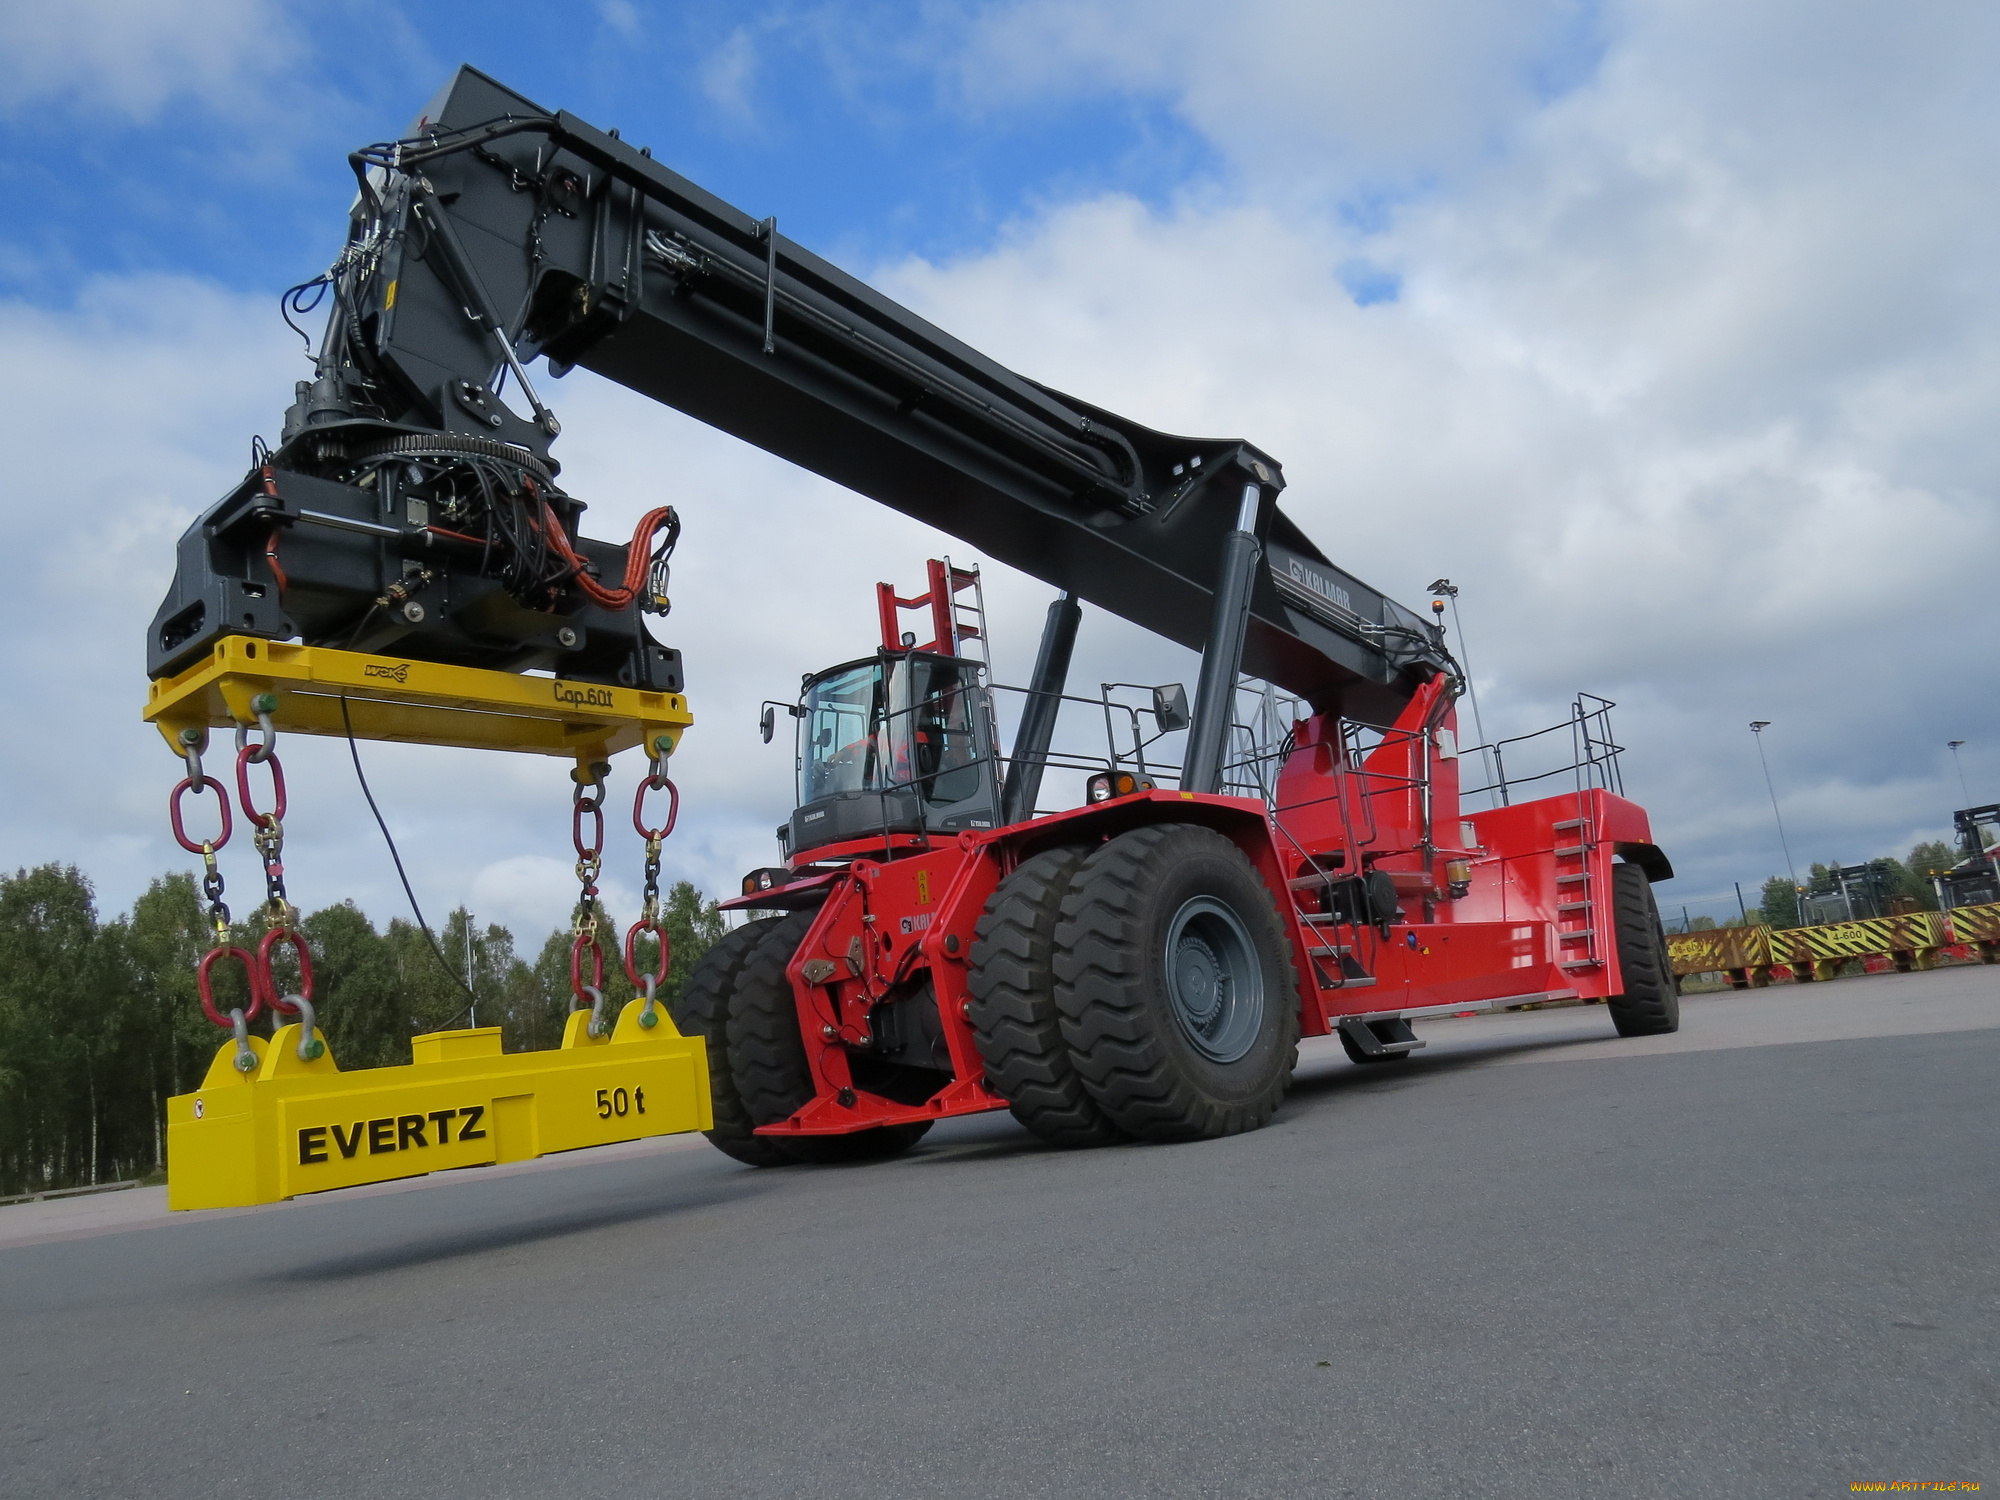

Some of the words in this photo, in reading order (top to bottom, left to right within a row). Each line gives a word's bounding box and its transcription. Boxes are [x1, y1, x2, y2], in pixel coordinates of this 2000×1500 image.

[1305, 568, 1350, 609] KALMAR
[1833, 930, 1862, 941] 4-600
[596, 1087, 628, 1119] 50
[635, 1085, 646, 1114] t
[298, 1105, 486, 1165] EVERTZ
